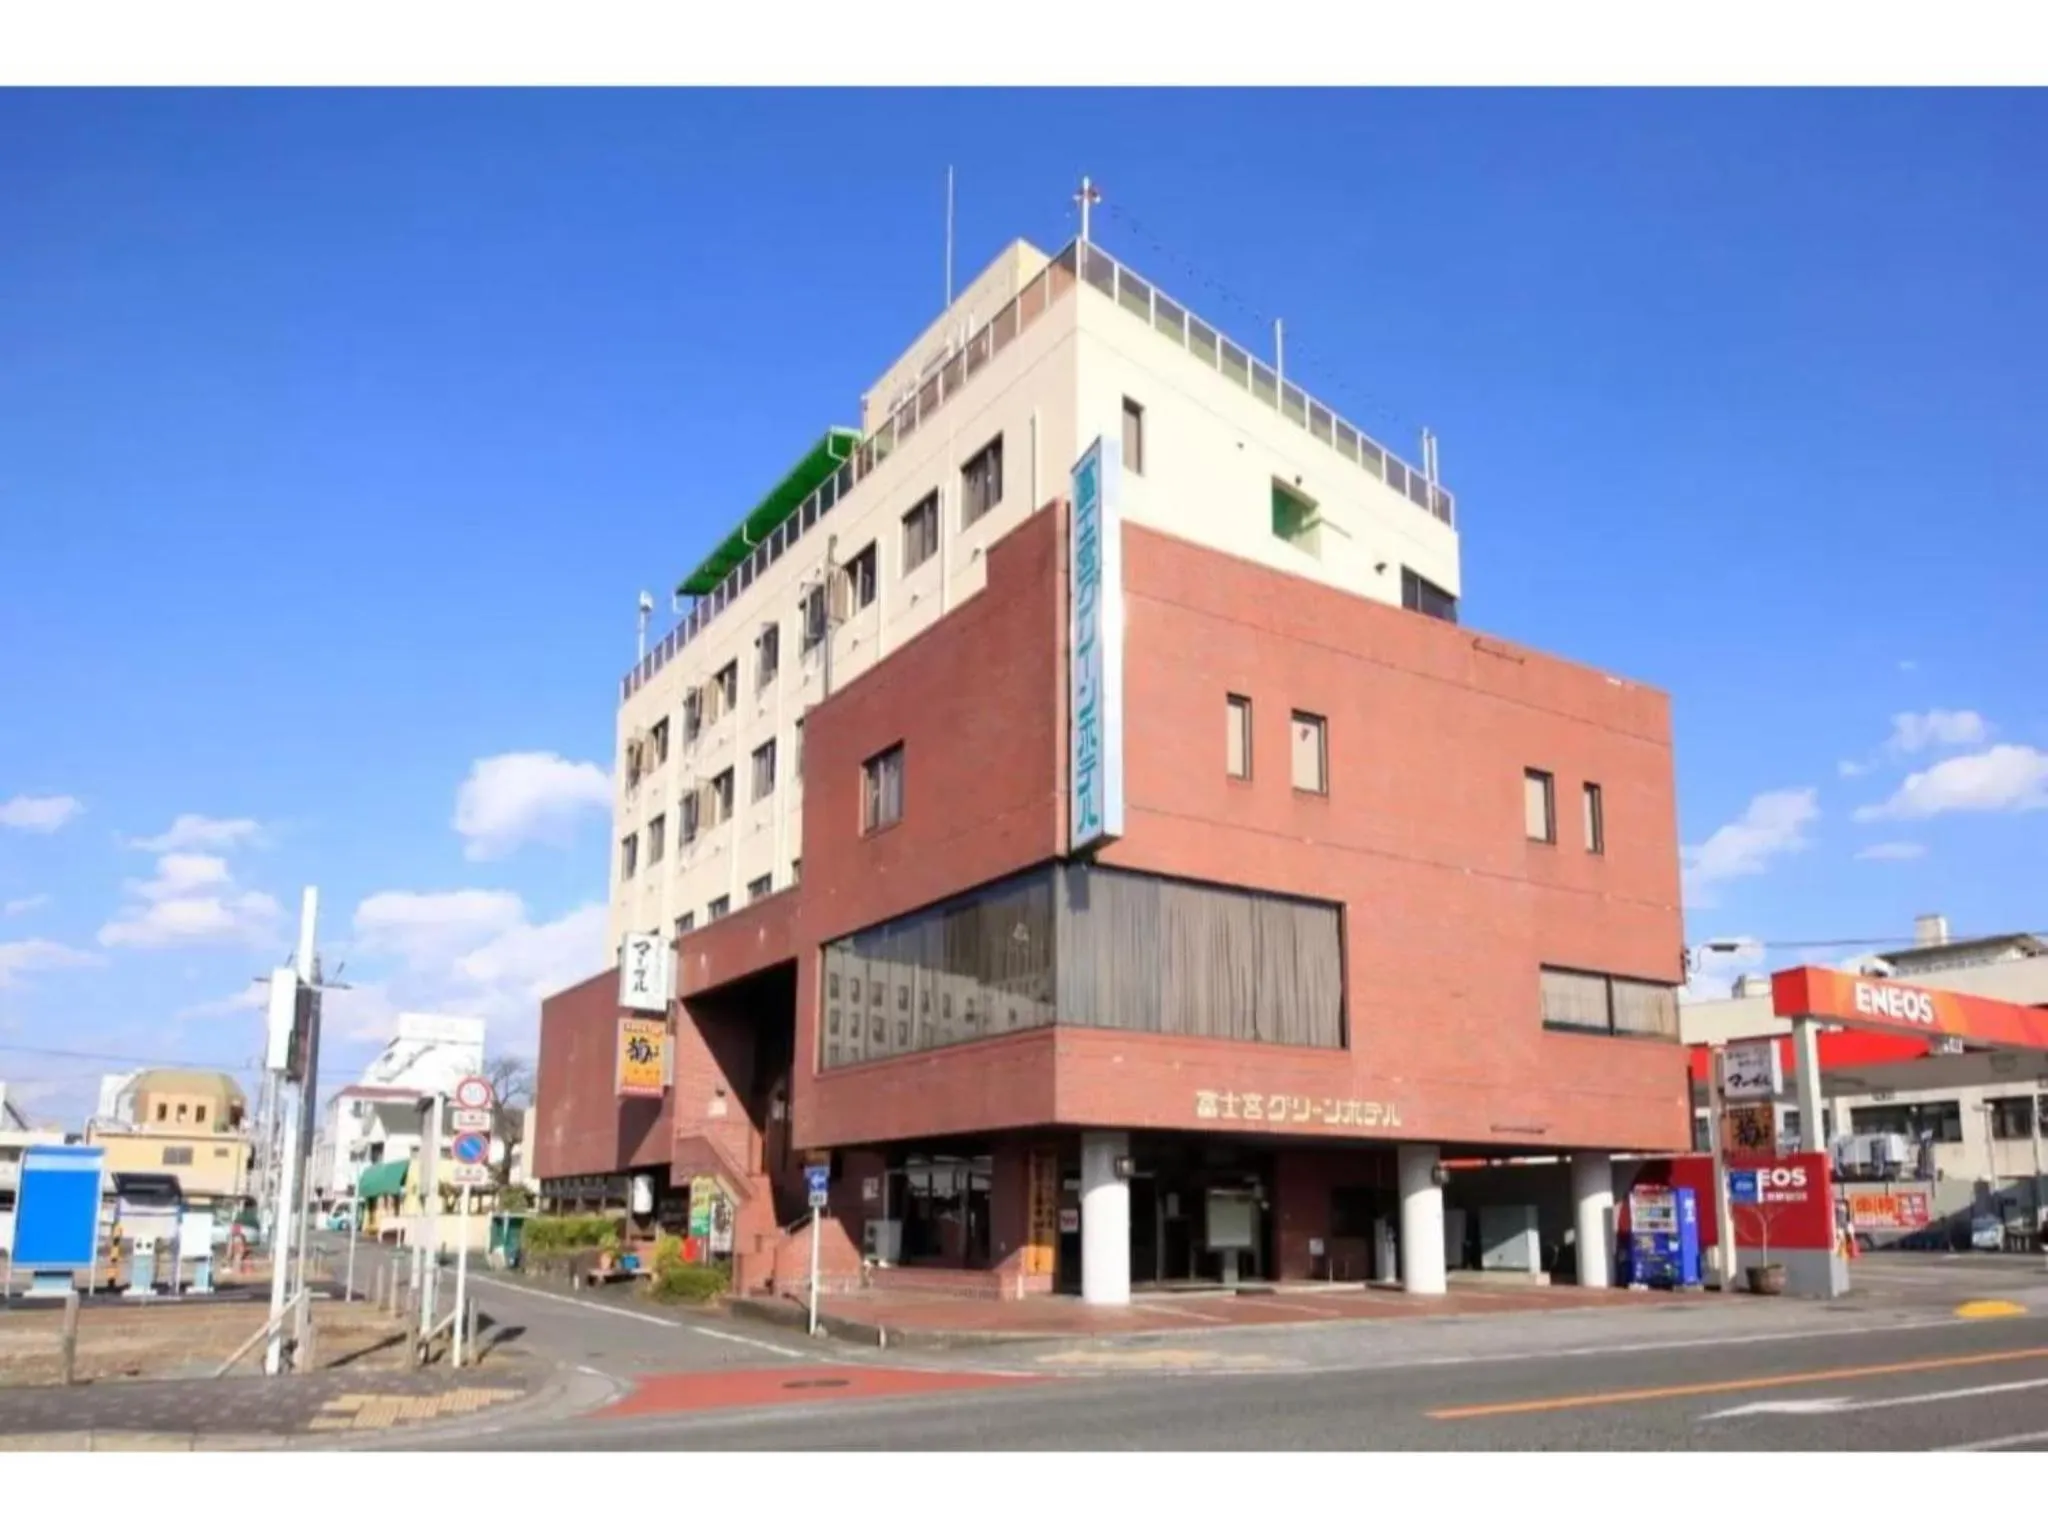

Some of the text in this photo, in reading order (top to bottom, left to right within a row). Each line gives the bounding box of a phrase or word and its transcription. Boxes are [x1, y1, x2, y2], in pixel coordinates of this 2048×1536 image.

[1855, 982, 1935, 1024] ENEOS
[1196, 1089, 1401, 1127] 富士宮グリーンホテル
